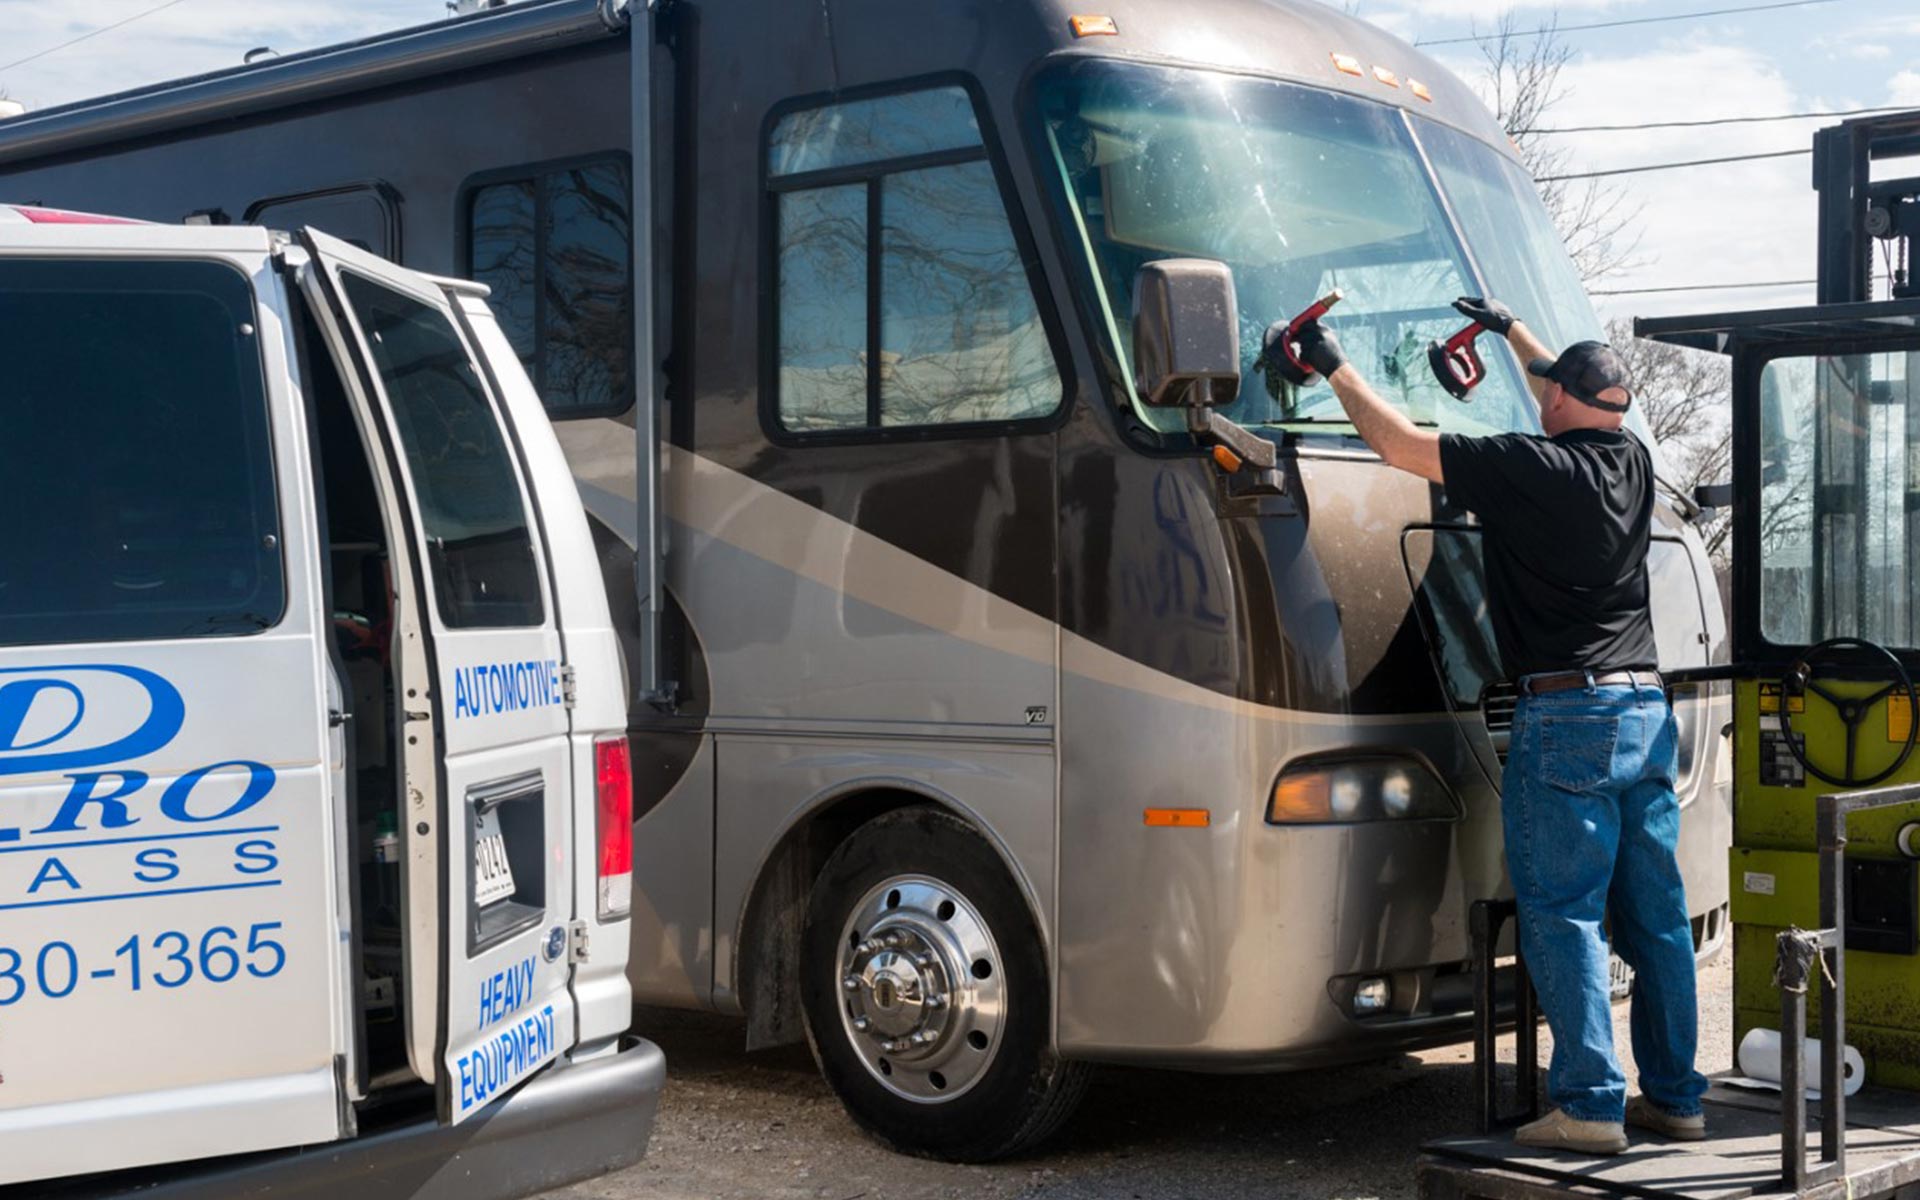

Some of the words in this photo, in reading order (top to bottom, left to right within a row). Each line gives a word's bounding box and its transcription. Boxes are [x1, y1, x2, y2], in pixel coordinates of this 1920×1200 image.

[455, 661, 560, 718] AUTOMOTIVE
[480, 956, 536, 1029] HEAVY
[457, 1005, 554, 1111] EQUIPMENT
